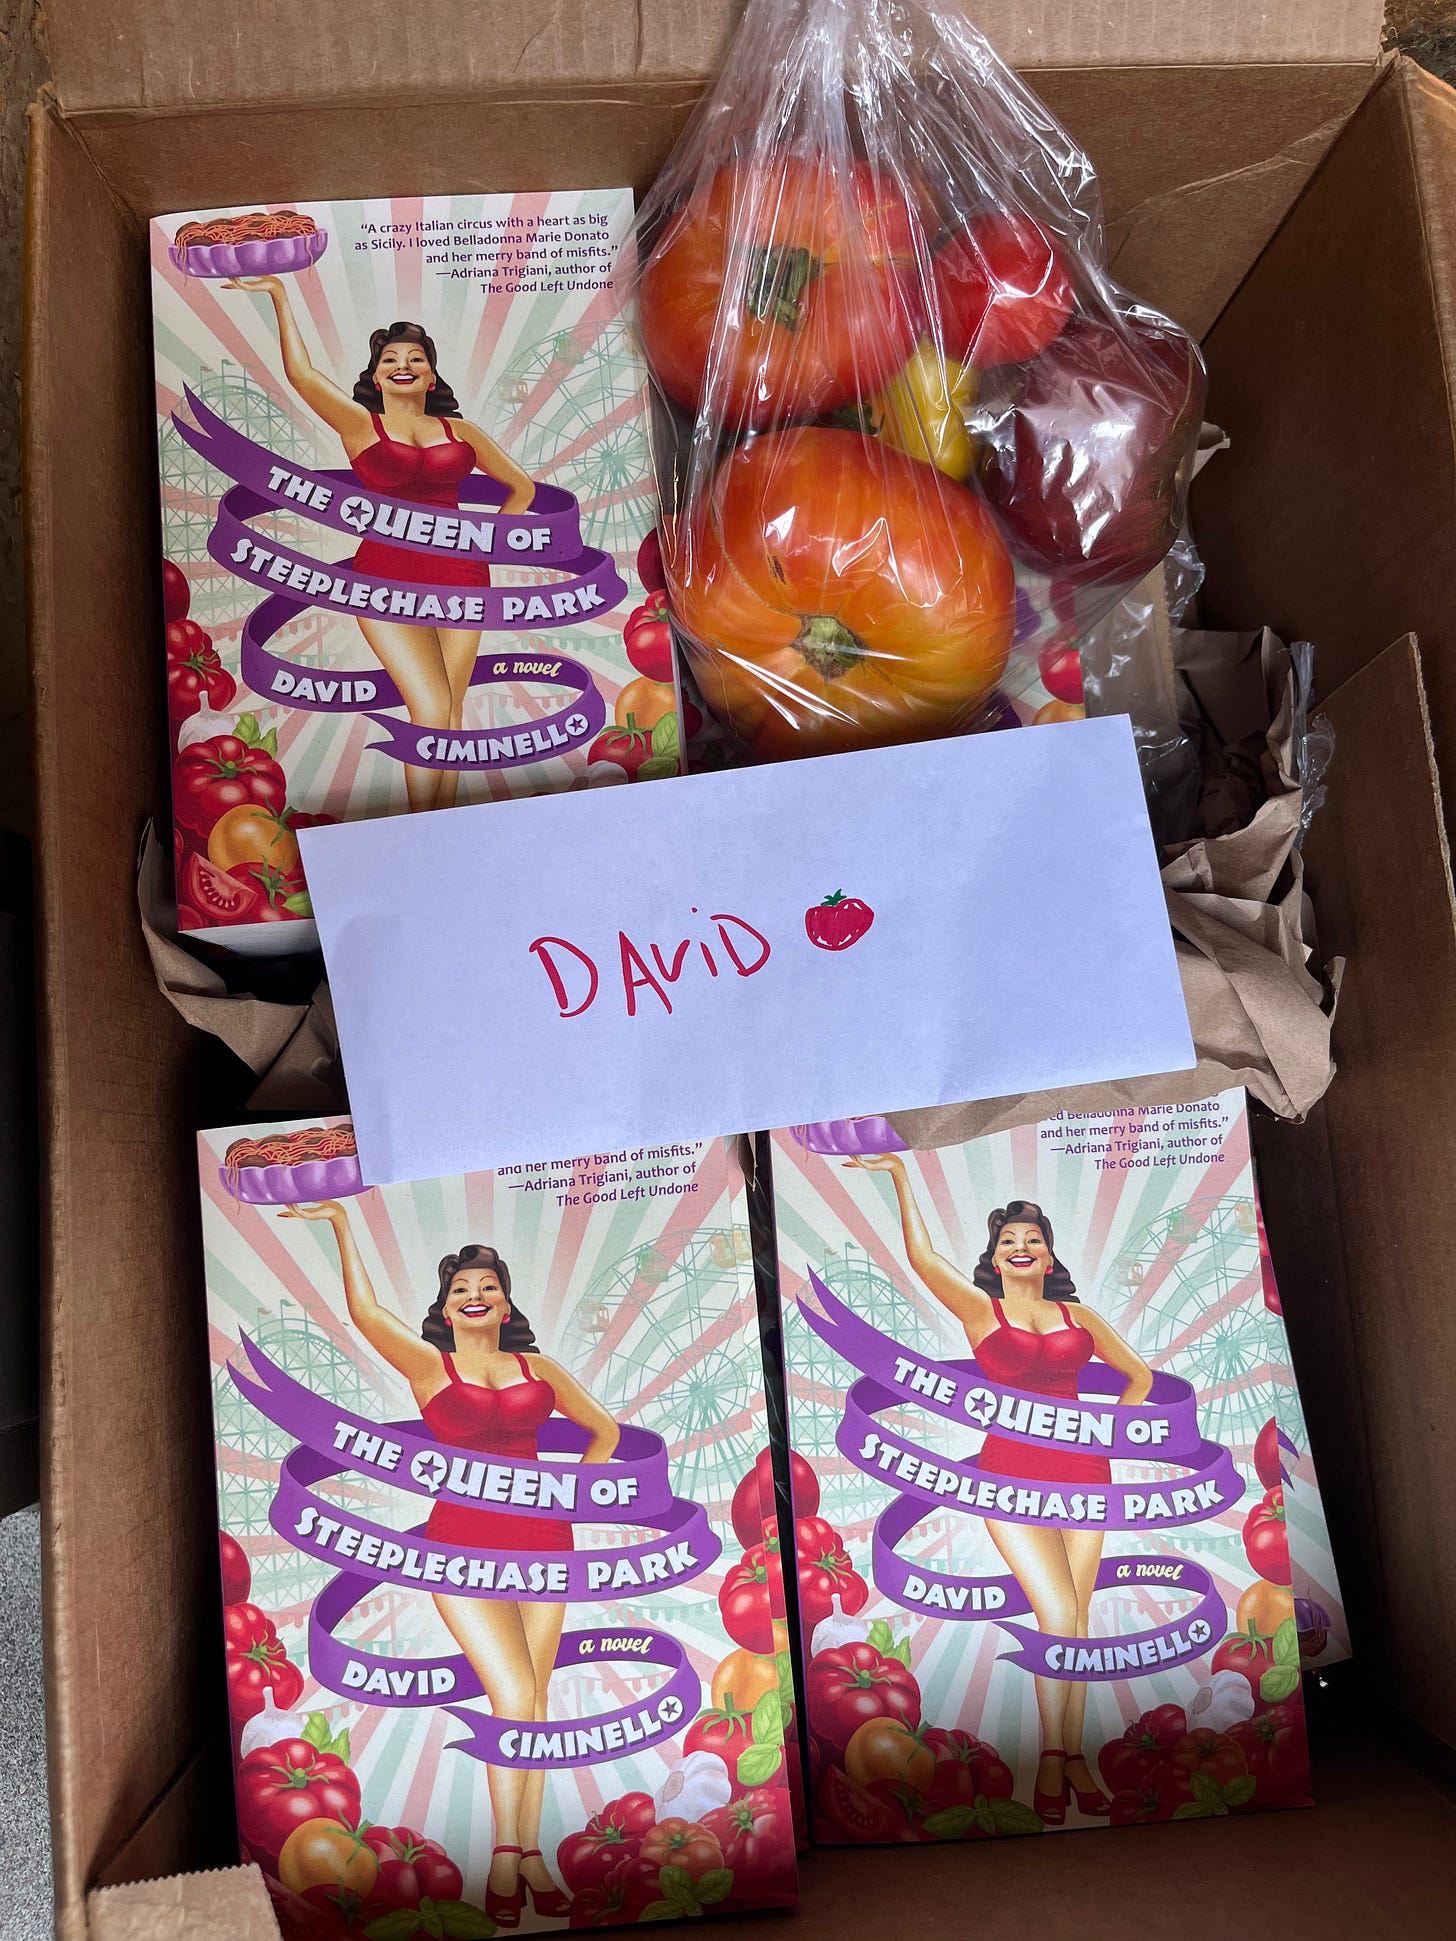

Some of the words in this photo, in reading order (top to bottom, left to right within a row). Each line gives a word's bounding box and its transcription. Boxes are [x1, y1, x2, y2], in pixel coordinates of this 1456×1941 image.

[361, 224, 376, 234] “A
[380, 224, 412, 235] crazy
[416, 220, 454, 232] Italian
[457, 219, 493, 230] circus
[496, 217, 524, 228] with
[527, 218, 534, 227] a
[537, 215, 570, 227] heart
[573, 216, 586, 225] as
[589, 213, 608, 226] big
[354, 242, 368, 251] as
[371, 238, 406, 251] Sicily.
[409, 238, 413, 248] I
[416, 236, 451, 247] loved
[454, 234, 523, 246] Belladonna
[526, 232, 561, 243] Marie
[565, 231, 609, 241] Donato
[426, 252, 448, 264] and
[452, 252, 473, 263] her
[476, 252, 513, 263] merry
[516, 249, 547, 260] band
[550, 247, 563, 258] of
[566, 245, 618, 258] misfits.”
[502, 265, 552, 278] Trigiani,
[555, 263, 596, 275] author
[599, 262, 612, 273] of
[480, 283, 503, 294] The
[505, 281, 537, 293] Good
[540, 280, 564, 293] Left
[567, 279, 614, 290] Undone
[268, 465, 332, 512] THE
[339, 495, 495, 554] QUEEN
[506, 528, 552, 552] OF
[230, 538, 485, 622] STEEPLECHASE
[502, 583, 606, 621] PARK
[493, 661, 508, 675] a
[513, 660, 562, 678] novel
[270, 670, 377, 704] DAVID
[416, 713, 589, 763] CIMINELLO
[1175, 1101, 1220, 1113] Donato
[1040, 1126, 1063, 1139] and
[1065, 1126, 1086, 1137] her
[1089, 1126, 1126, 1137] merry
[1128, 1121, 1159, 1133] band
[1162, 1120, 1175, 1131] of
[1178, 1116, 1229, 1130] misfits.”
[551, 1157, 591, 1170] merry
[594, 1150, 627, 1165] band
[630, 1148, 644, 1161] of
[647, 1142, 702, 1159] misfits.”
[1114, 1138, 1164, 1154] Trigiani,
[1167, 1135, 1207, 1148] author
[1210, 1133, 1223, 1145] of
[578, 1169, 632, 1187] Trigiani,
[635, 1165, 679, 1180] author
[682, 1161, 696, 1174] of
[1094, 1159, 1116, 1170] The
[1119, 1155, 1150, 1169] Good
[1153, 1154, 1177, 1168] Left
[1179, 1152, 1225, 1165] Undone
[556, 1194, 580, 1207] The
[583, 1189, 617, 1203] Good
[620, 1186, 646, 1201] Left
[649, 1182, 699, 1197] Undone
[893, 1357, 957, 1405] THE
[964, 1387, 1114, 1446] QUEEN
[1126, 1420, 1169, 1444] OF
[333, 1421, 403, 1471] THE
[410, 1449, 577, 1511] QUEEN
[590, 1478, 638, 1506] OF
[859, 1433, 1106, 1521] STEEPLECHASE
[1123, 1479, 1224, 1520] PARK
[294, 1506, 568, 1592] STEEPLECHASE
[587, 1540, 699, 1590] PARK
[1116, 1564, 1131, 1579] a
[1136, 1563, 1183, 1580] novel
[902, 1574, 1007, 1612] DAVID
[578, 1638, 595, 1655] a
[600, 1635, 653, 1655] novel
[1044, 1619, 1212, 1672] CIMINELLO
[341, 1660, 456, 1697] DAVID
[499, 1695, 684, 1761] CIMINELLO
